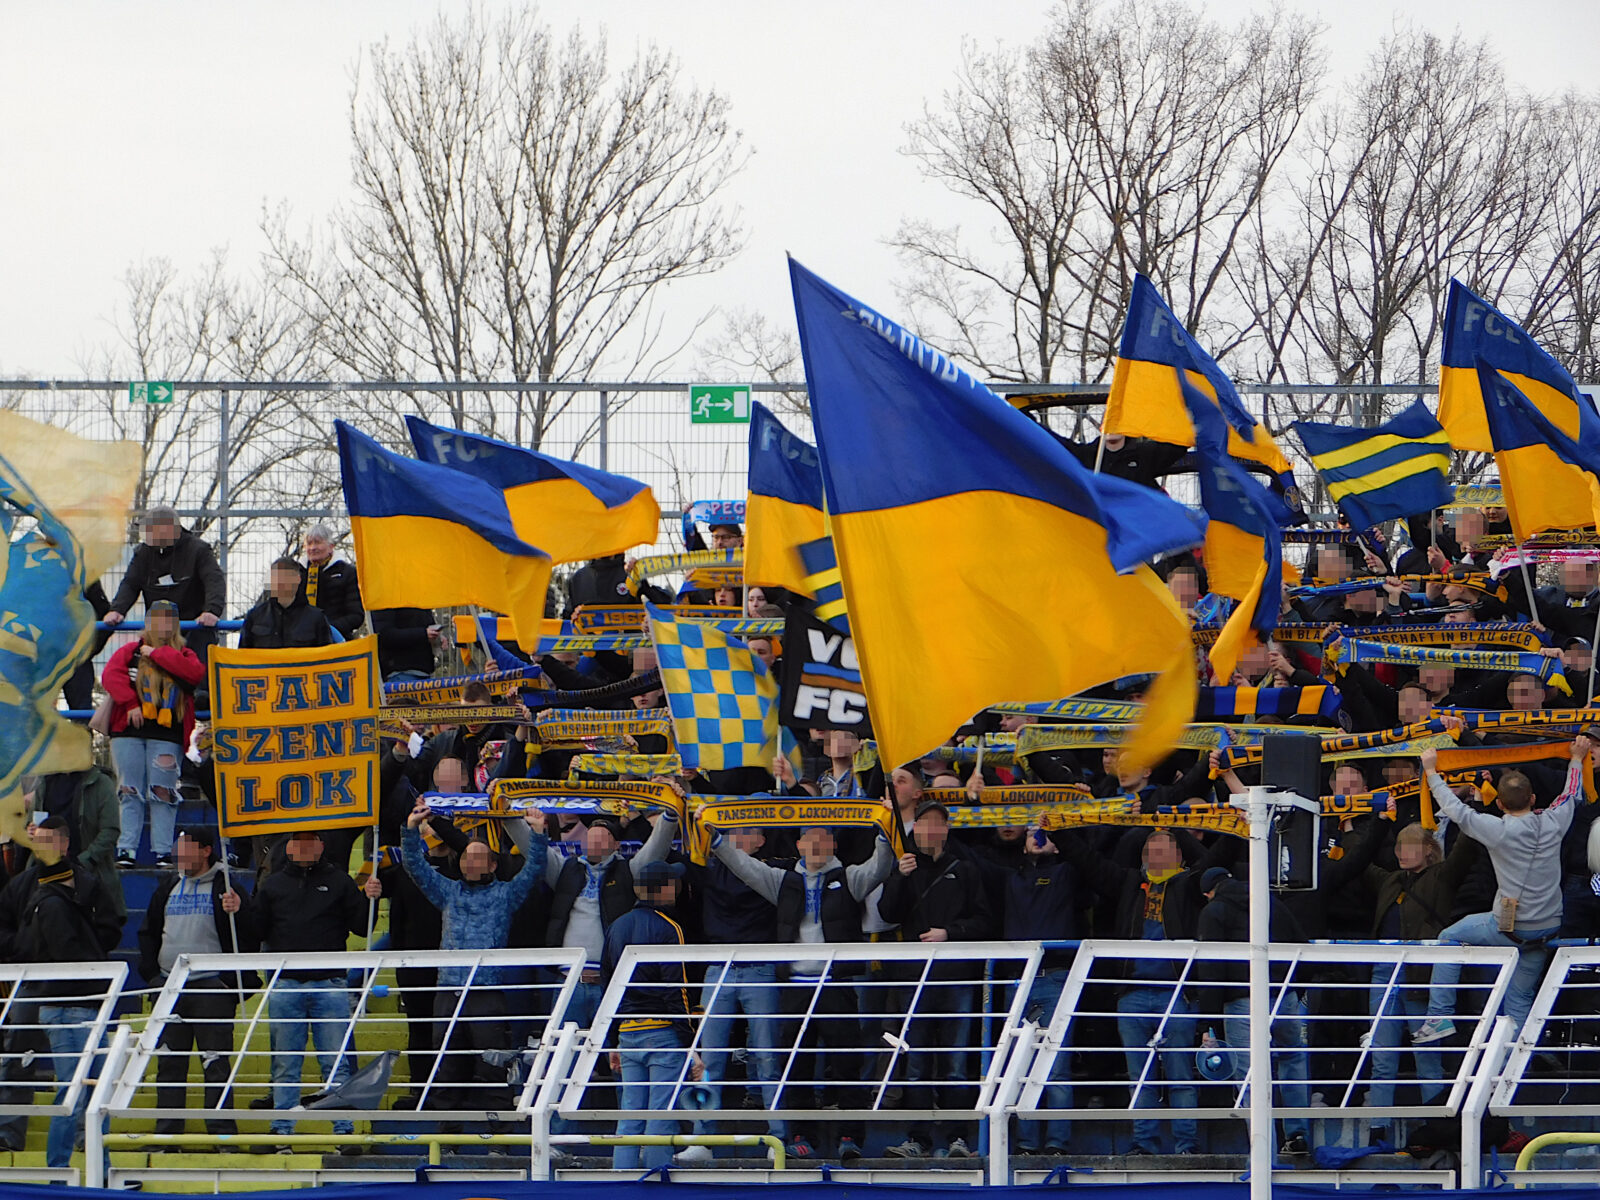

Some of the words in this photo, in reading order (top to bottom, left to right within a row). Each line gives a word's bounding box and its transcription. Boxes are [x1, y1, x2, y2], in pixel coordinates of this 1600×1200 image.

[1298, 630, 1322, 640] BLA
[1441, 632, 1455, 642] IN
[1460, 632, 1496, 642] BLAU
[1500, 632, 1533, 646] GELB
[1400, 646, 1420, 659] FC
[1459, 651, 1519, 666] LEIPZIG
[232, 668, 356, 714] FAN
[793, 685, 867, 723] FC
[215, 716, 379, 764] SZENE
[237, 768, 356, 815] LOK
[585, 780, 664, 796] LOKOMOTIVE
[717, 807, 776, 821] FANSZENE
[798, 807, 873, 820] LOKOMOTIVE
